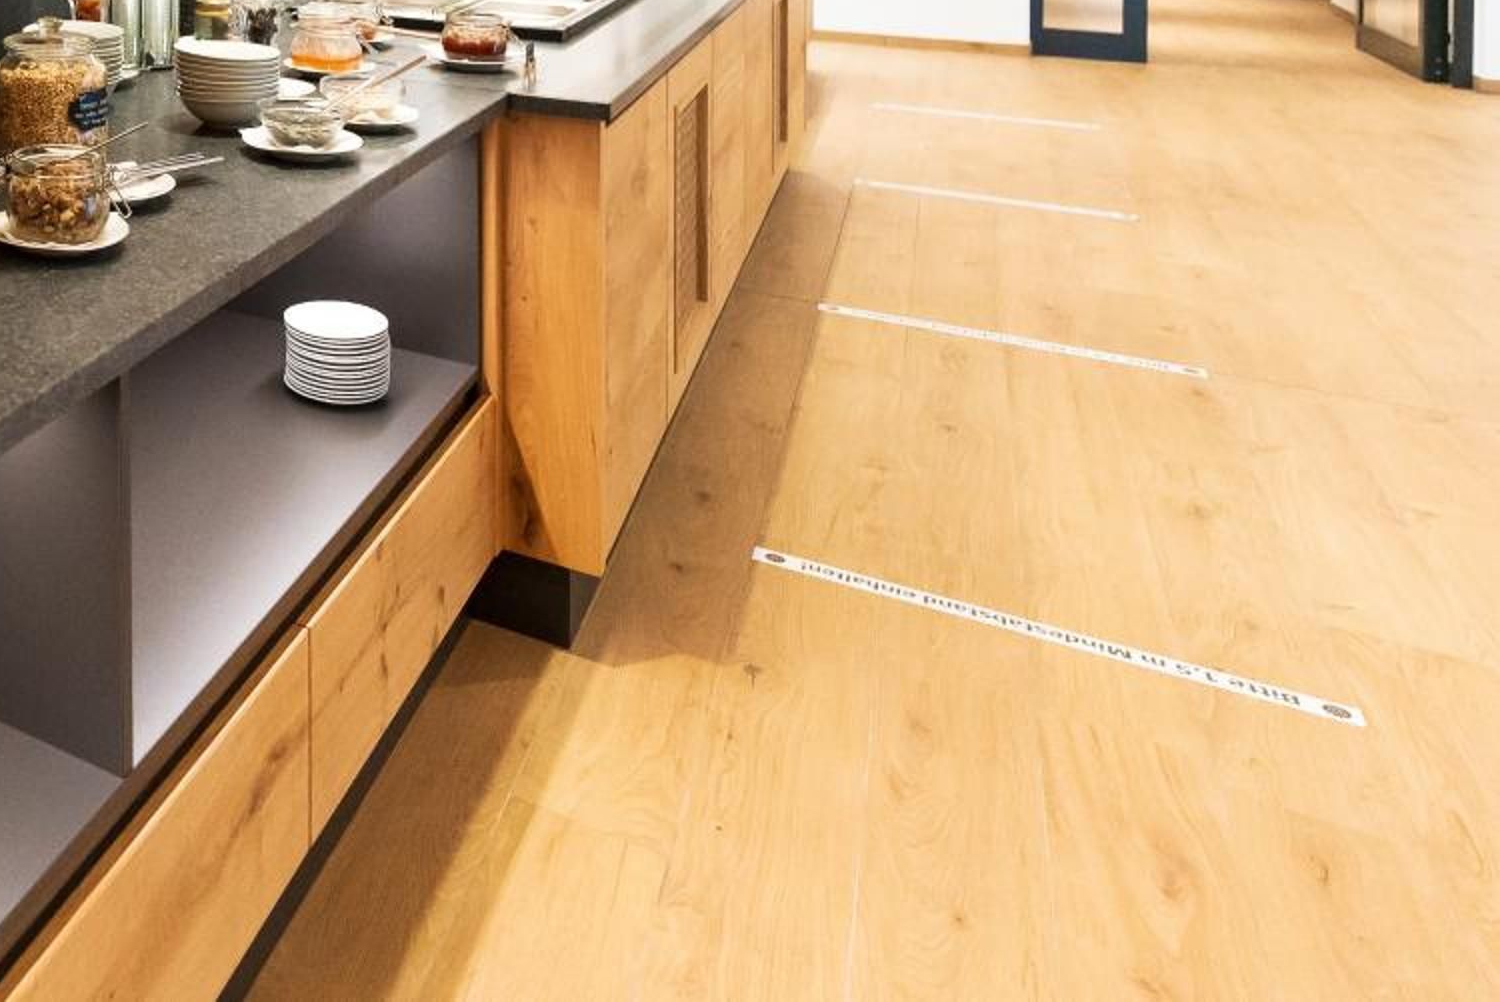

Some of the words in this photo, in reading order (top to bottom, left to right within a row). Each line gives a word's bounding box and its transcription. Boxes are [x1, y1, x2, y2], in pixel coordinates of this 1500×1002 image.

[801, 560, 917, 598] einhalten!
[922, 594, 1132, 660] Mindestabstand
[1140, 654, 1166, 667] m
[1175, 663, 1218, 683] 1,5
[1228, 677, 1301, 706] Bitte
